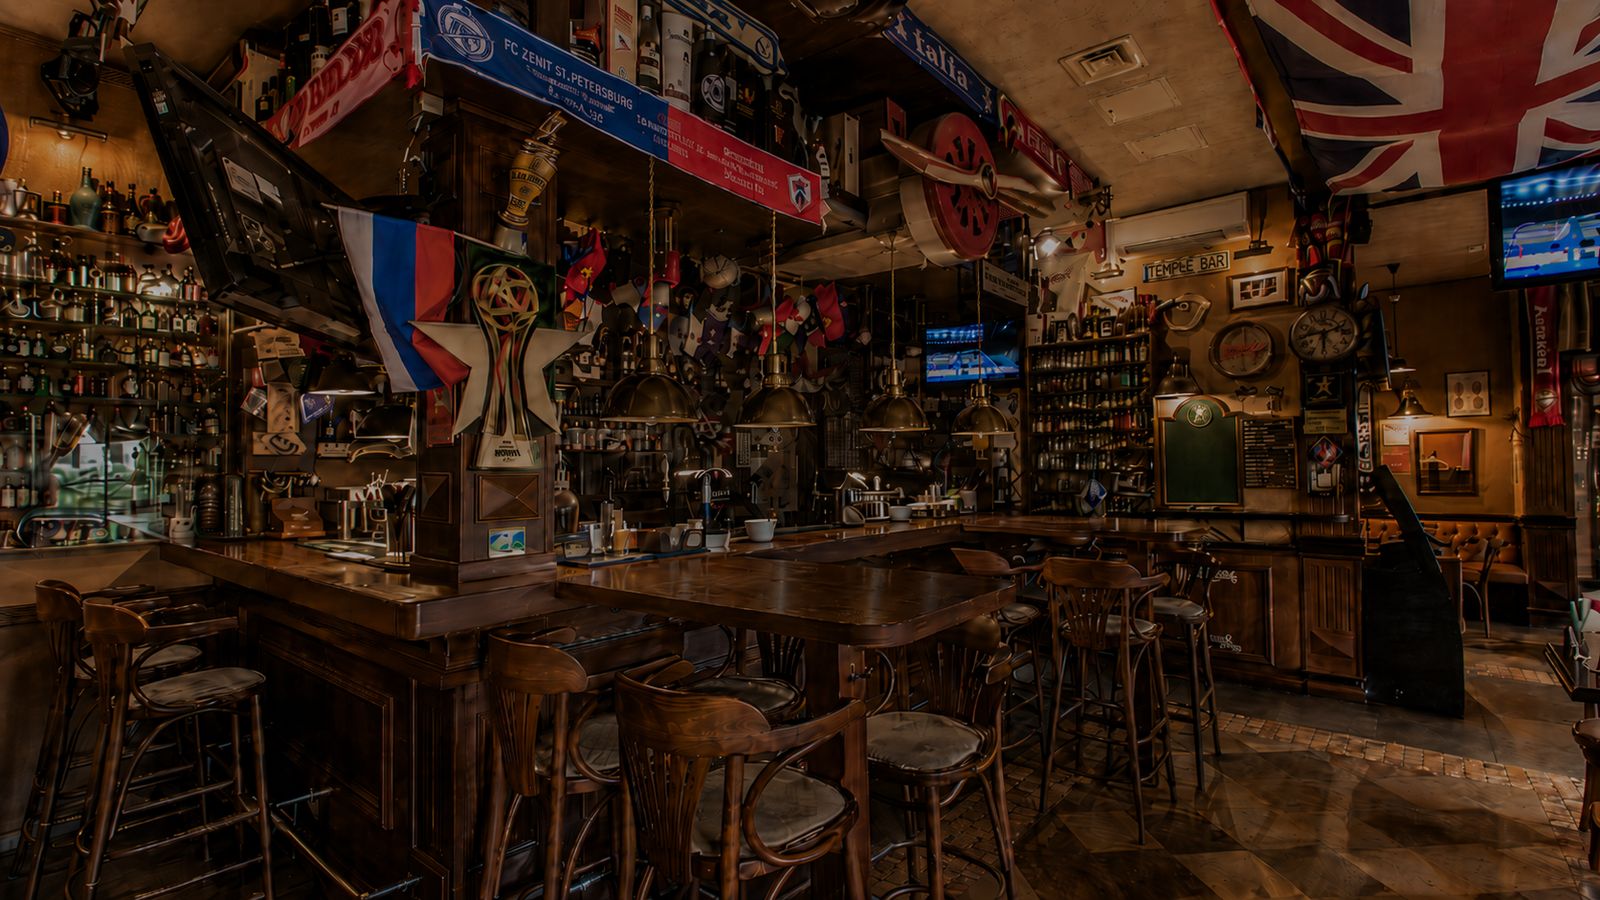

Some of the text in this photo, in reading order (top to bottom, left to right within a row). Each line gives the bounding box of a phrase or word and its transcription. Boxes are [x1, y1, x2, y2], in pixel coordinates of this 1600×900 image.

[503, 37, 519, 56] FC
[521, 44, 553, 72] ZENIT
[1148, 254, 1225, 278] TEMPLE BAR
